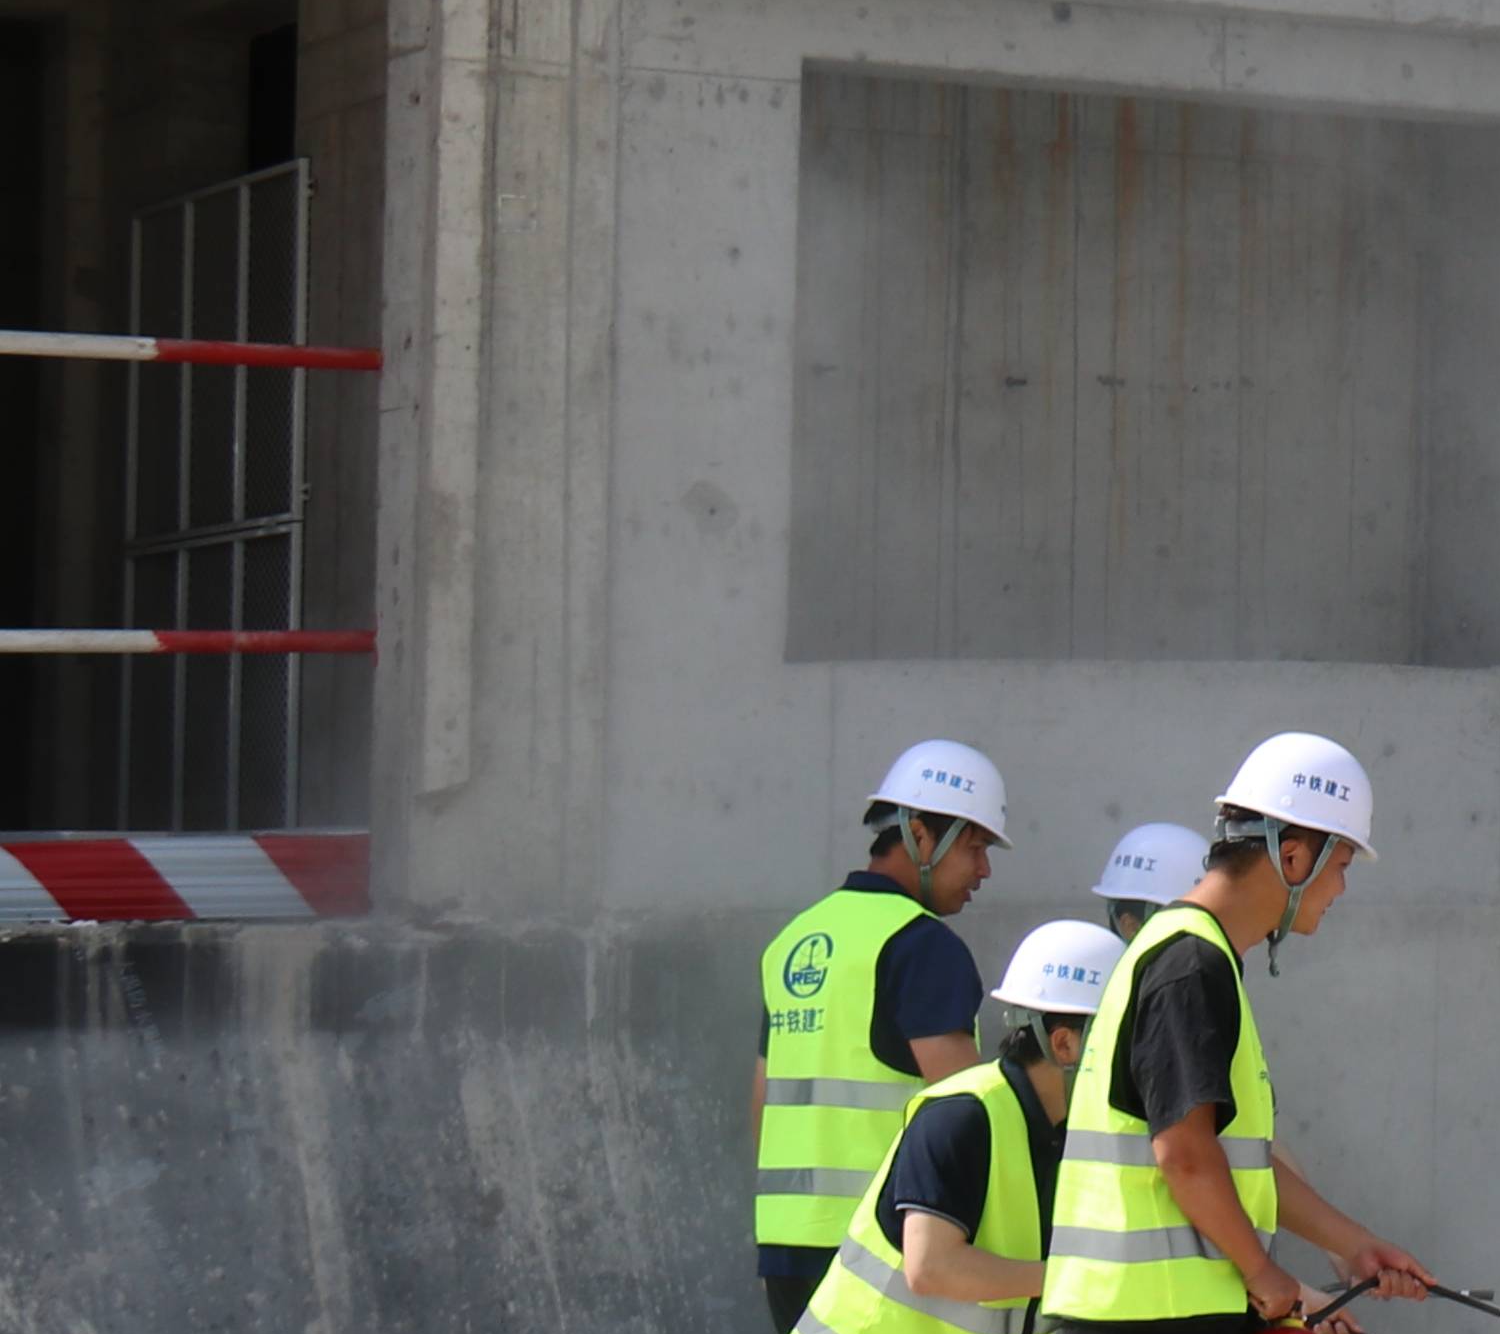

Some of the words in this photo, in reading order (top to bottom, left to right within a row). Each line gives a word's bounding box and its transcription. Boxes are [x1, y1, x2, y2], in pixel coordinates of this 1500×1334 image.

[921, 767, 977, 795] 中铁建工
[1292, 771, 1352, 803] 中铁建工
[1042, 962, 1102, 986] 中铁建工
